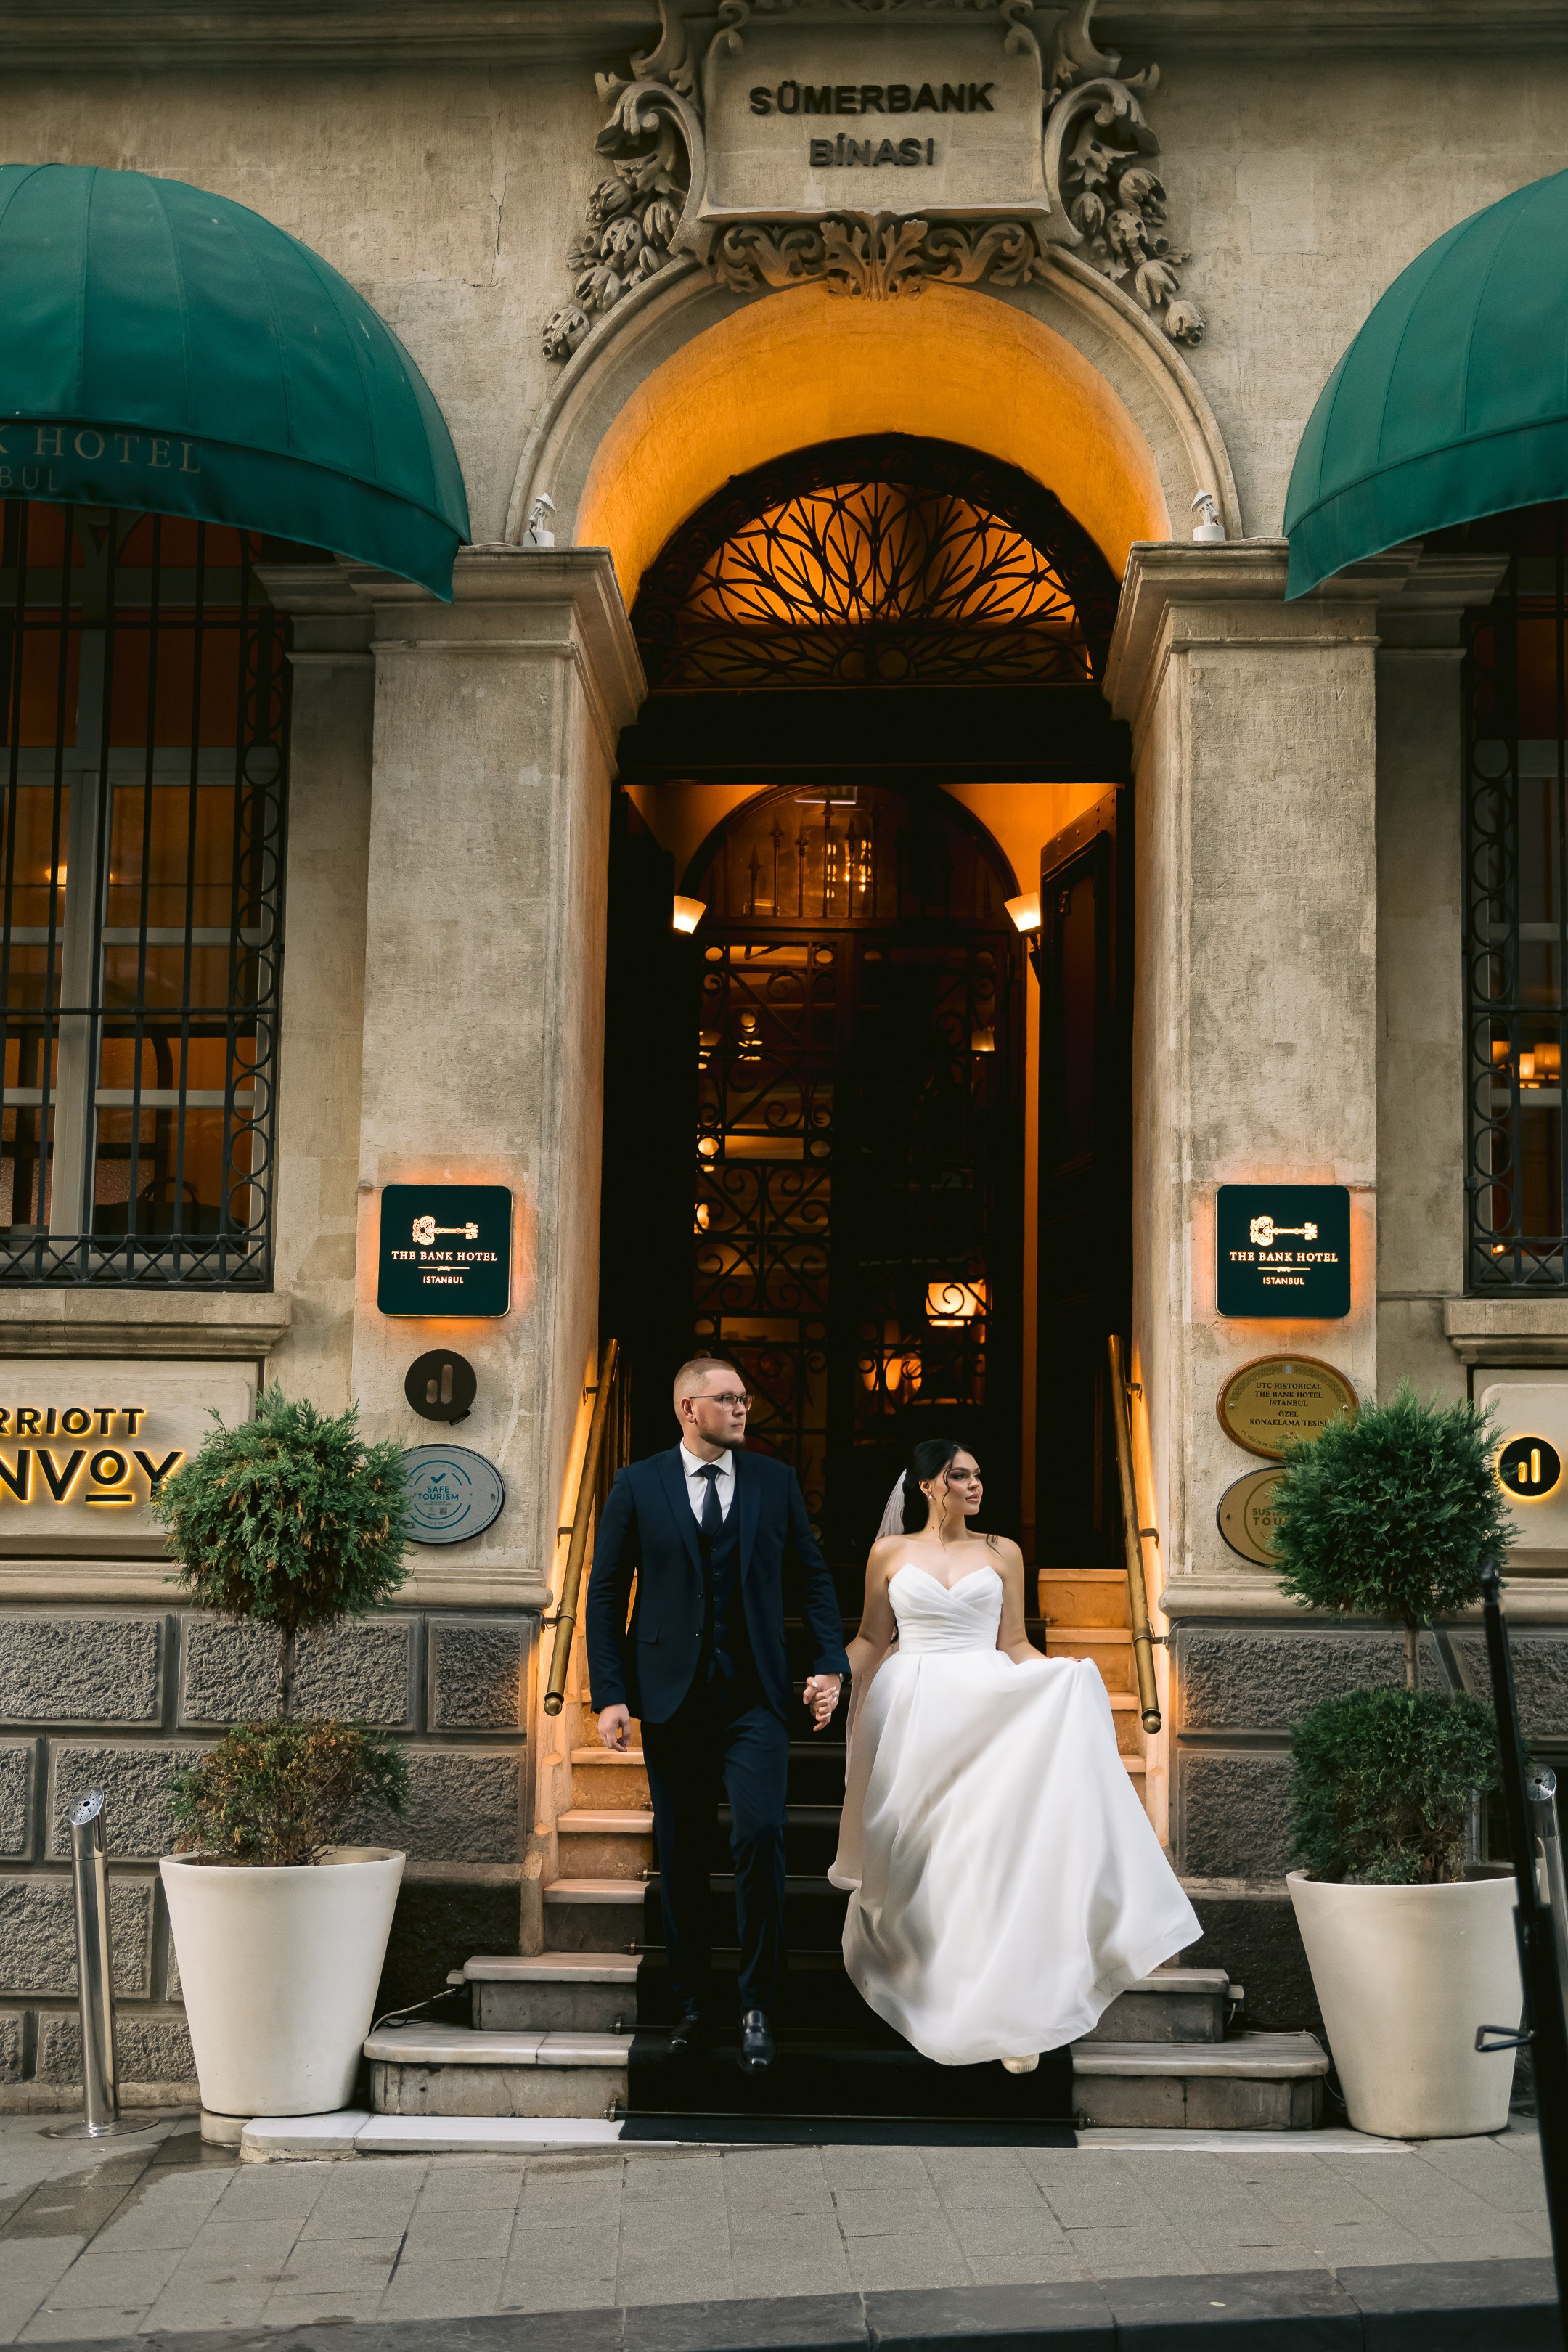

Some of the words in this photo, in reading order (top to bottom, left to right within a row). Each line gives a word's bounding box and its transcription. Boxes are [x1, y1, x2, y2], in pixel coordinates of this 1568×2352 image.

[749, 80, 995, 115] SÜMERBANK
[809, 133, 934, 166] BİNASI
[33, 425, 201, 473] HOTEL
[391, 1251, 416, 1260] THE
[420, 1251, 453, 1261] BANK
[457, 1252, 498, 1262] HOTEL
[1229, 1251, 1255, 1261] THE
[1259, 1252, 1293, 1262] BANK
[1296, 1252, 1339, 1262] HOTEL
[422, 1275, 464, 1284] ISTANBUL
[1262, 1276, 1305, 1286] ISTANBUL
[1278, 1409, 1299, 1418] ÖZEL
